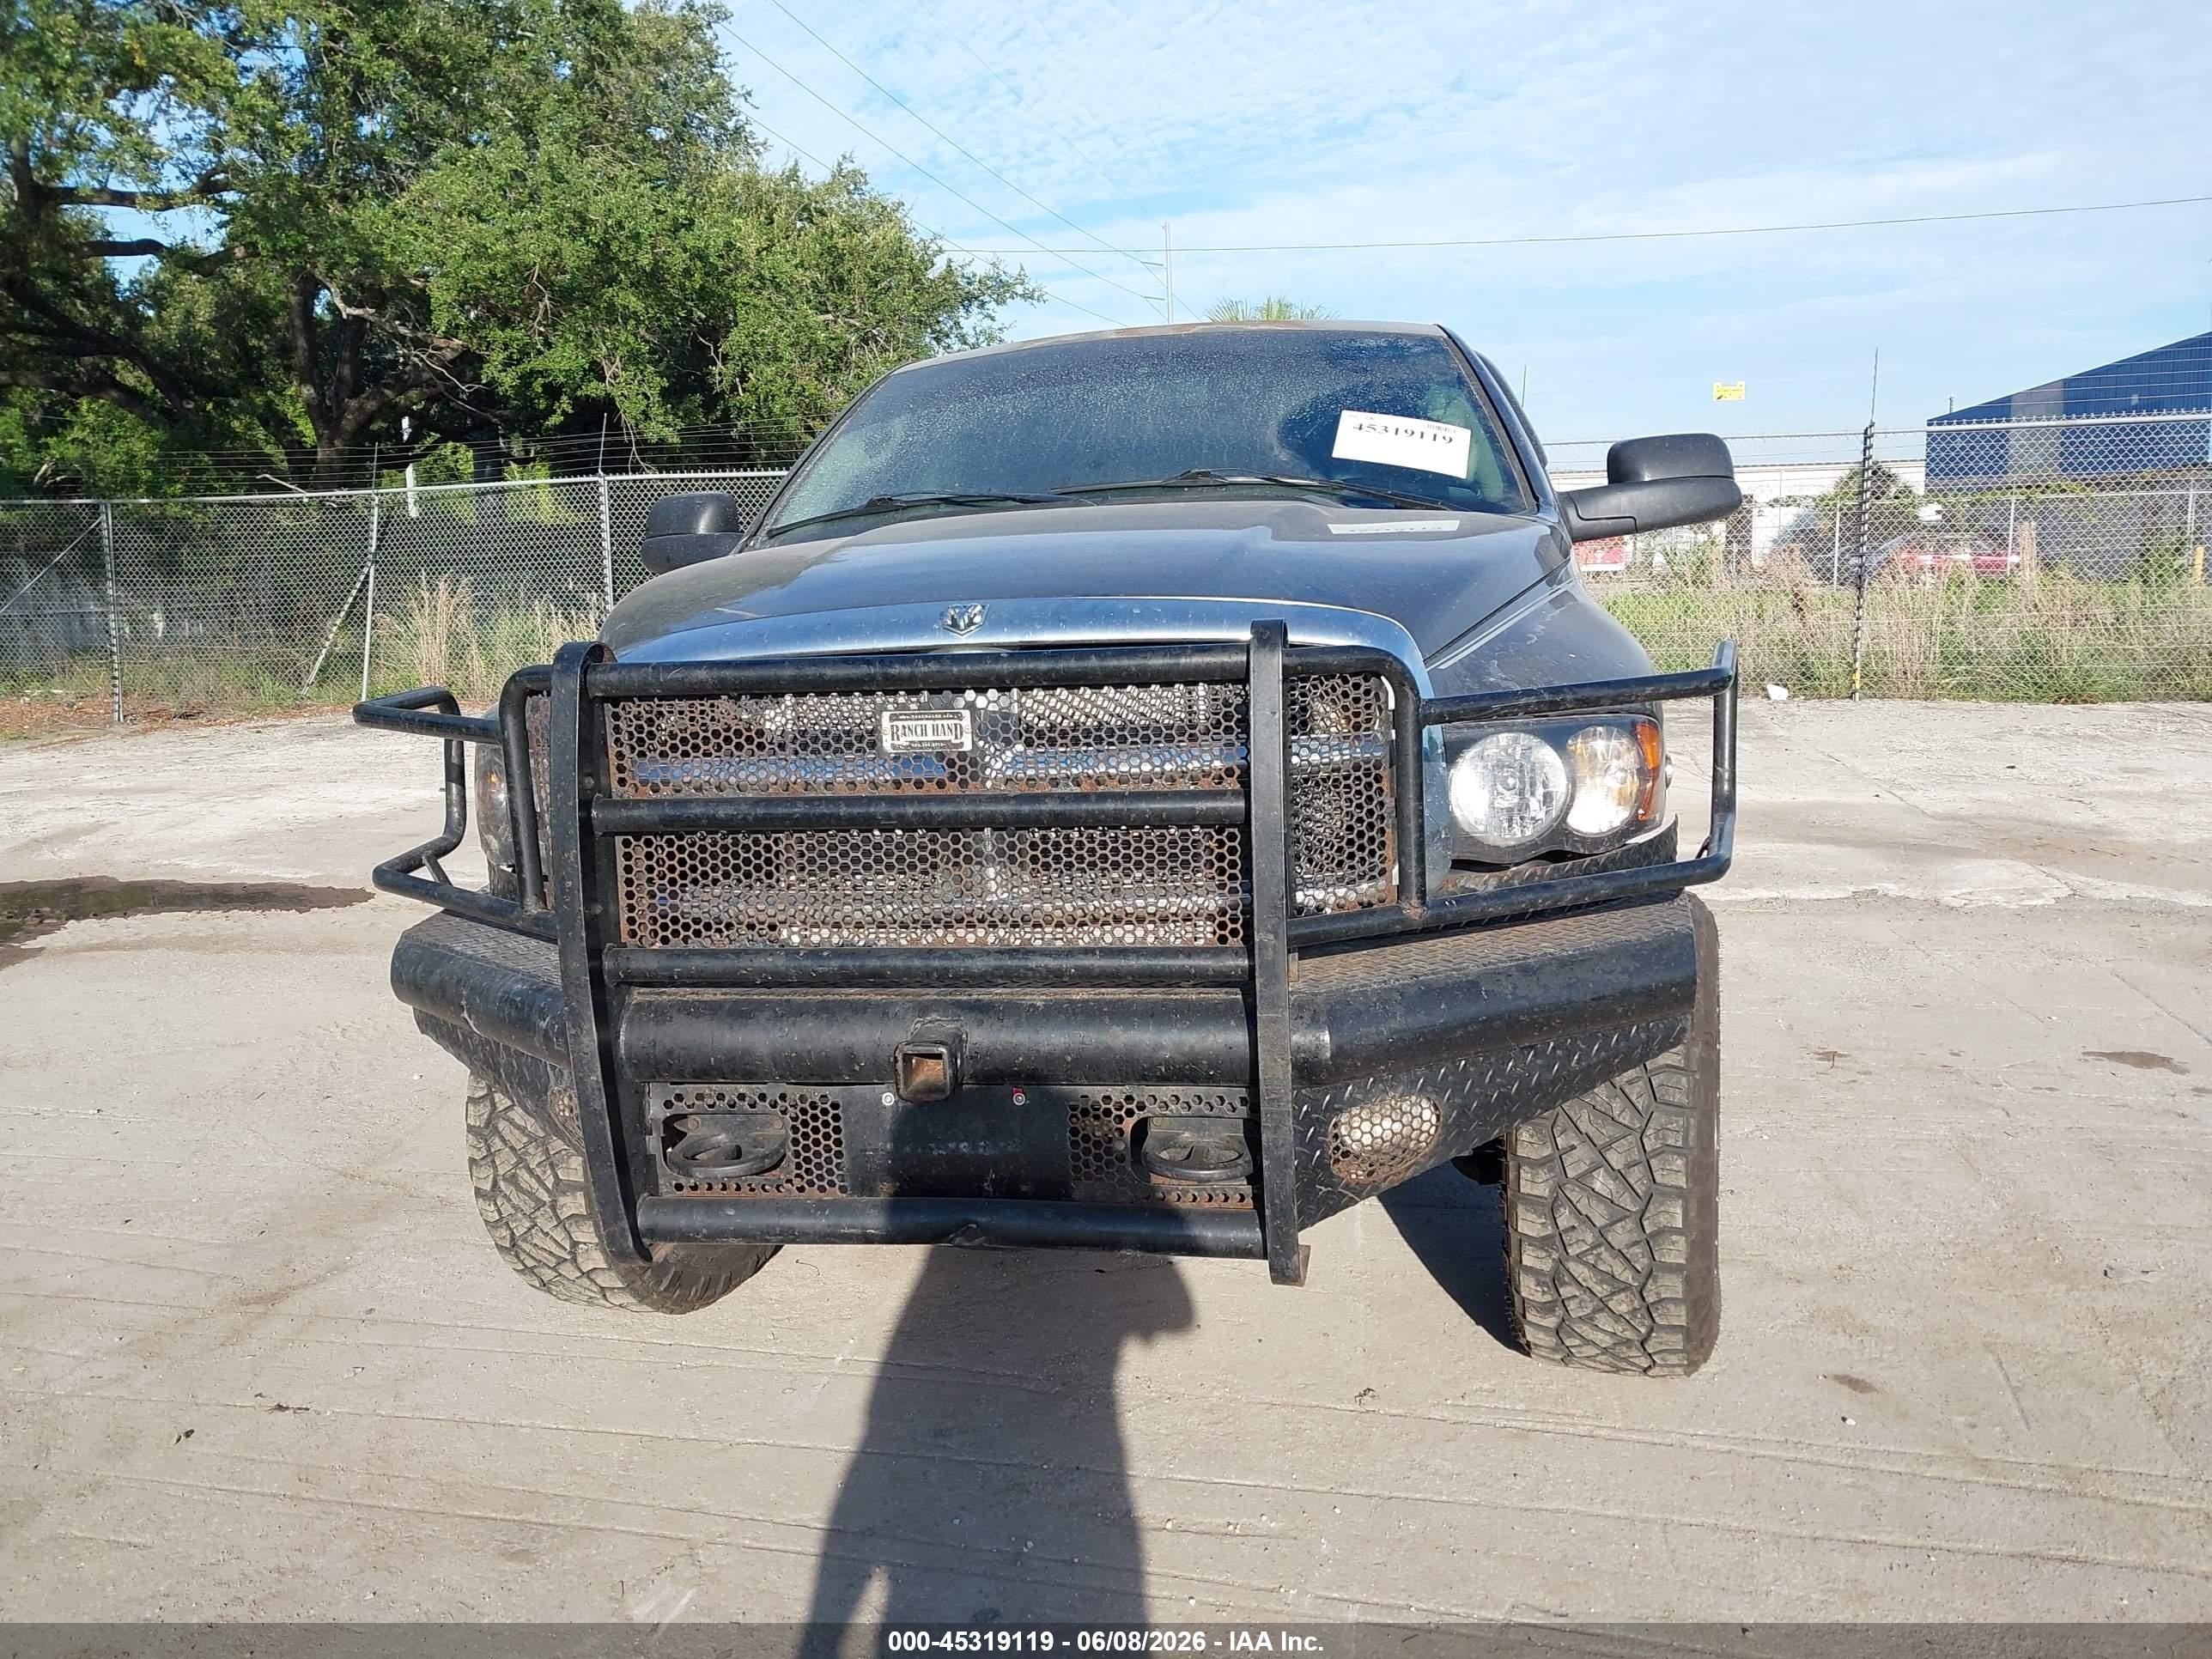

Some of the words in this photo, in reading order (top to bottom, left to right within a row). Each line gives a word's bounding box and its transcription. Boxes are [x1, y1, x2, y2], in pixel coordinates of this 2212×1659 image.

[1352, 422, 1454, 444] 45319119
[890, 723, 928, 742] RANCH
[932, 722, 964, 740] HAND
